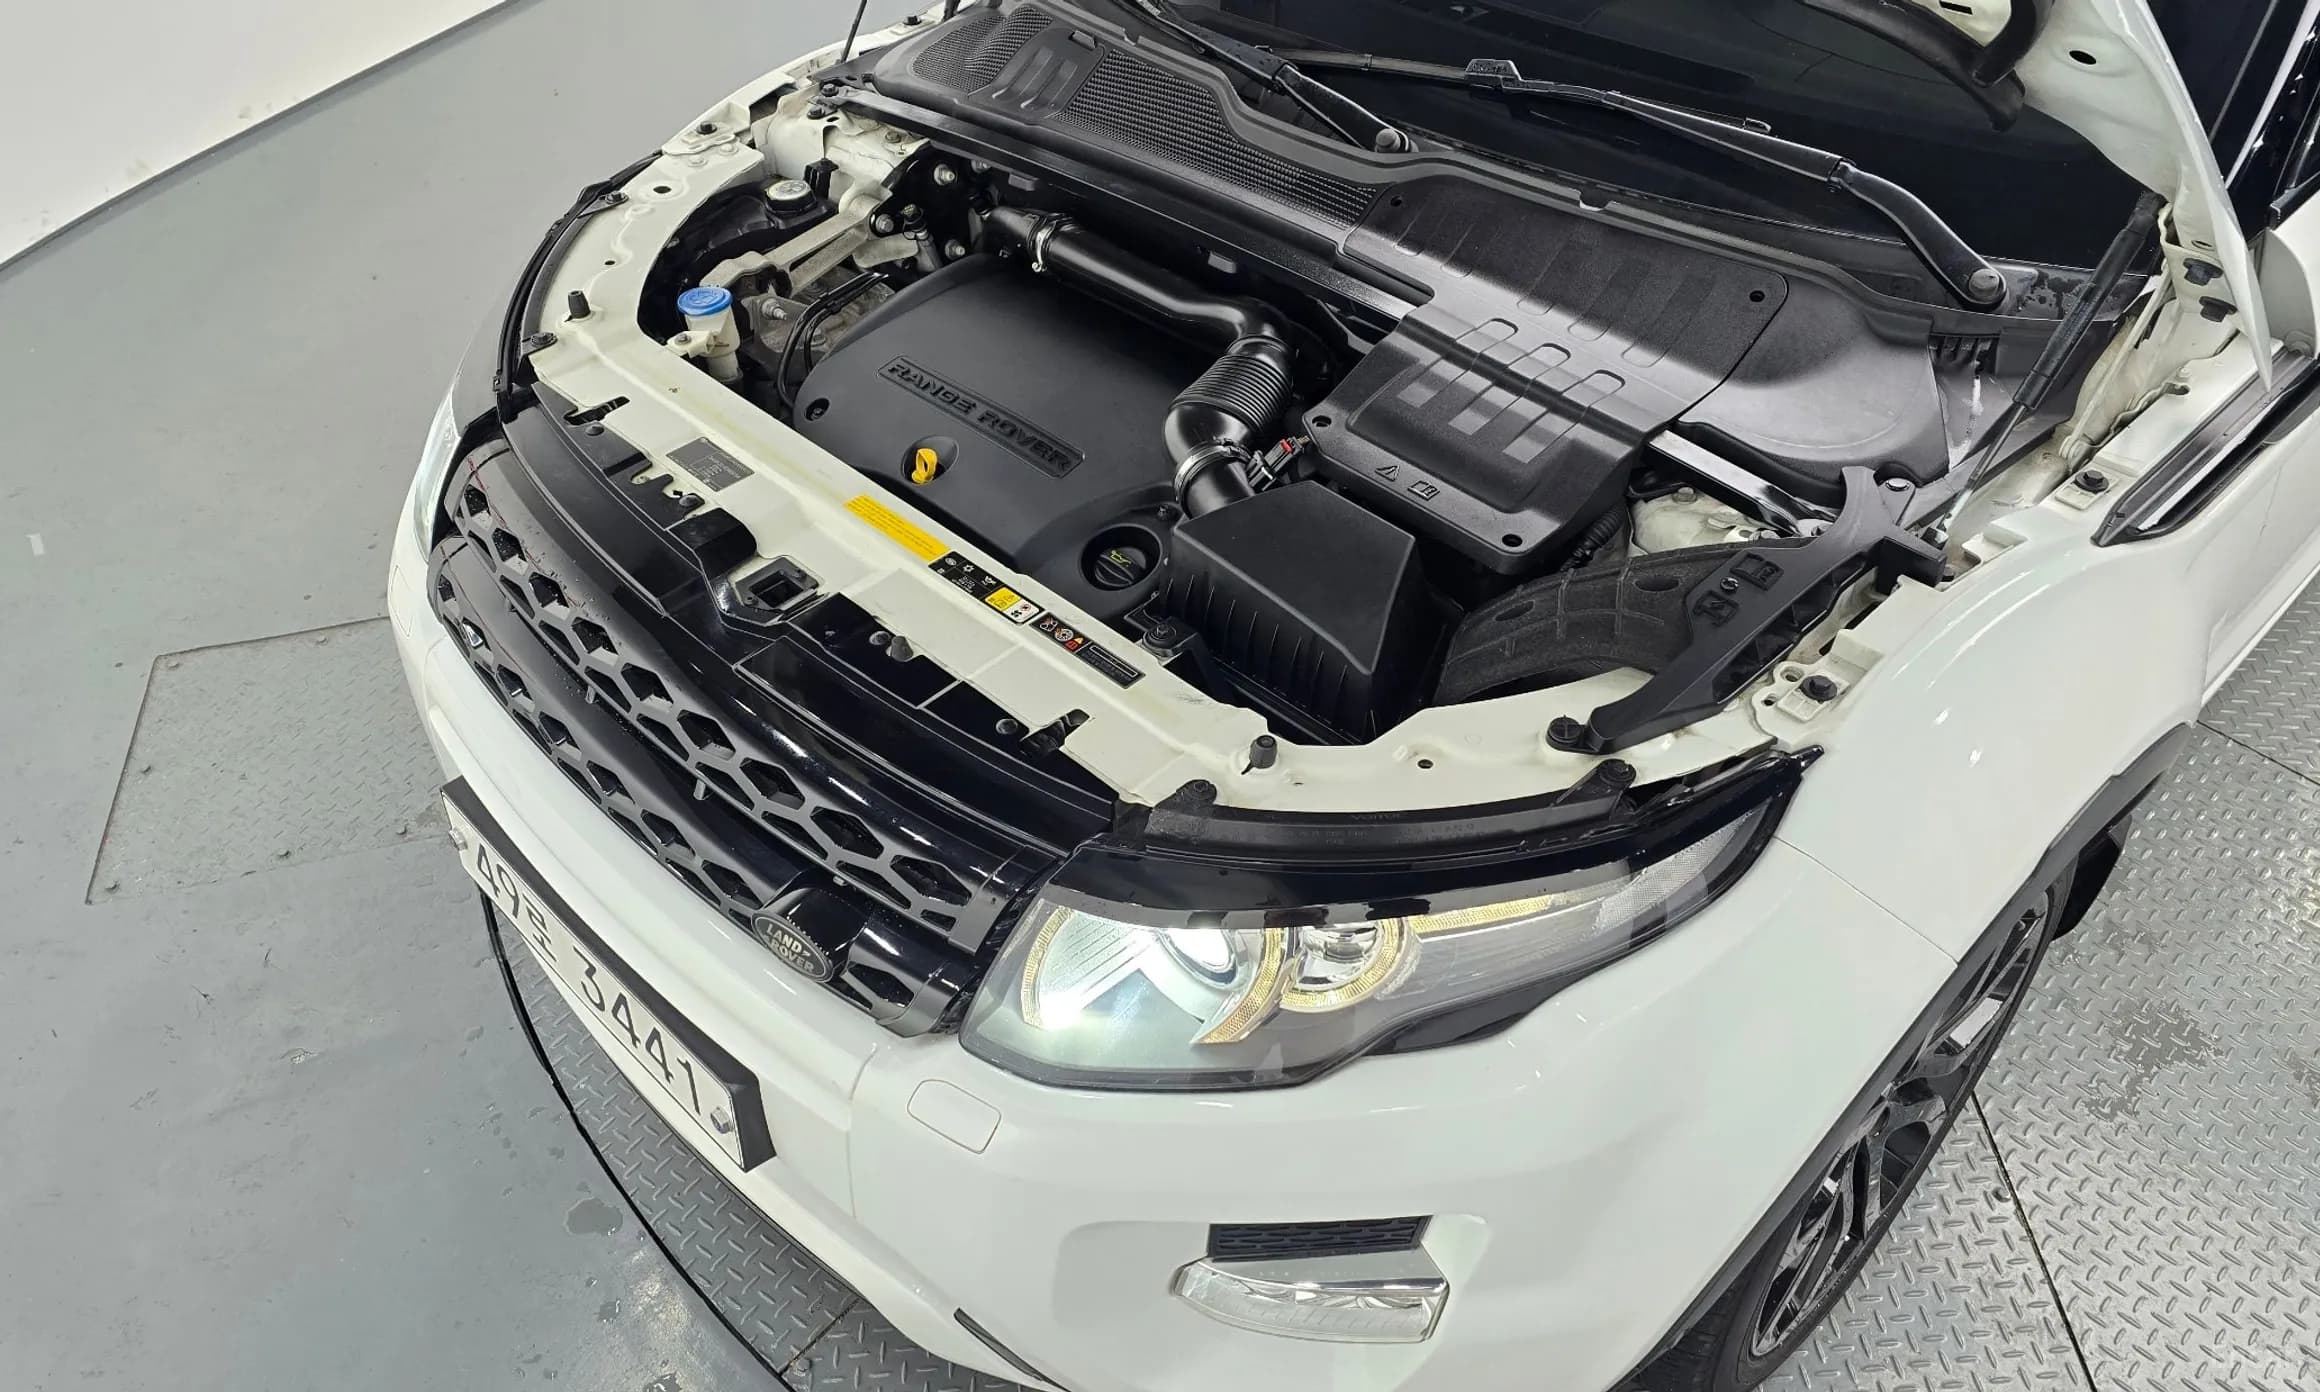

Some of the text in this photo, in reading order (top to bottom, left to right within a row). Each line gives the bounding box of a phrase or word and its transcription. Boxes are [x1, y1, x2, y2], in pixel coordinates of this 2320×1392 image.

[888, 364, 1072, 472] RANGE ROVER
[766, 923, 802, 953] LAND
[771, 938, 815, 973] ROVER
[477, 842, 701, 1116] 49로 3441
